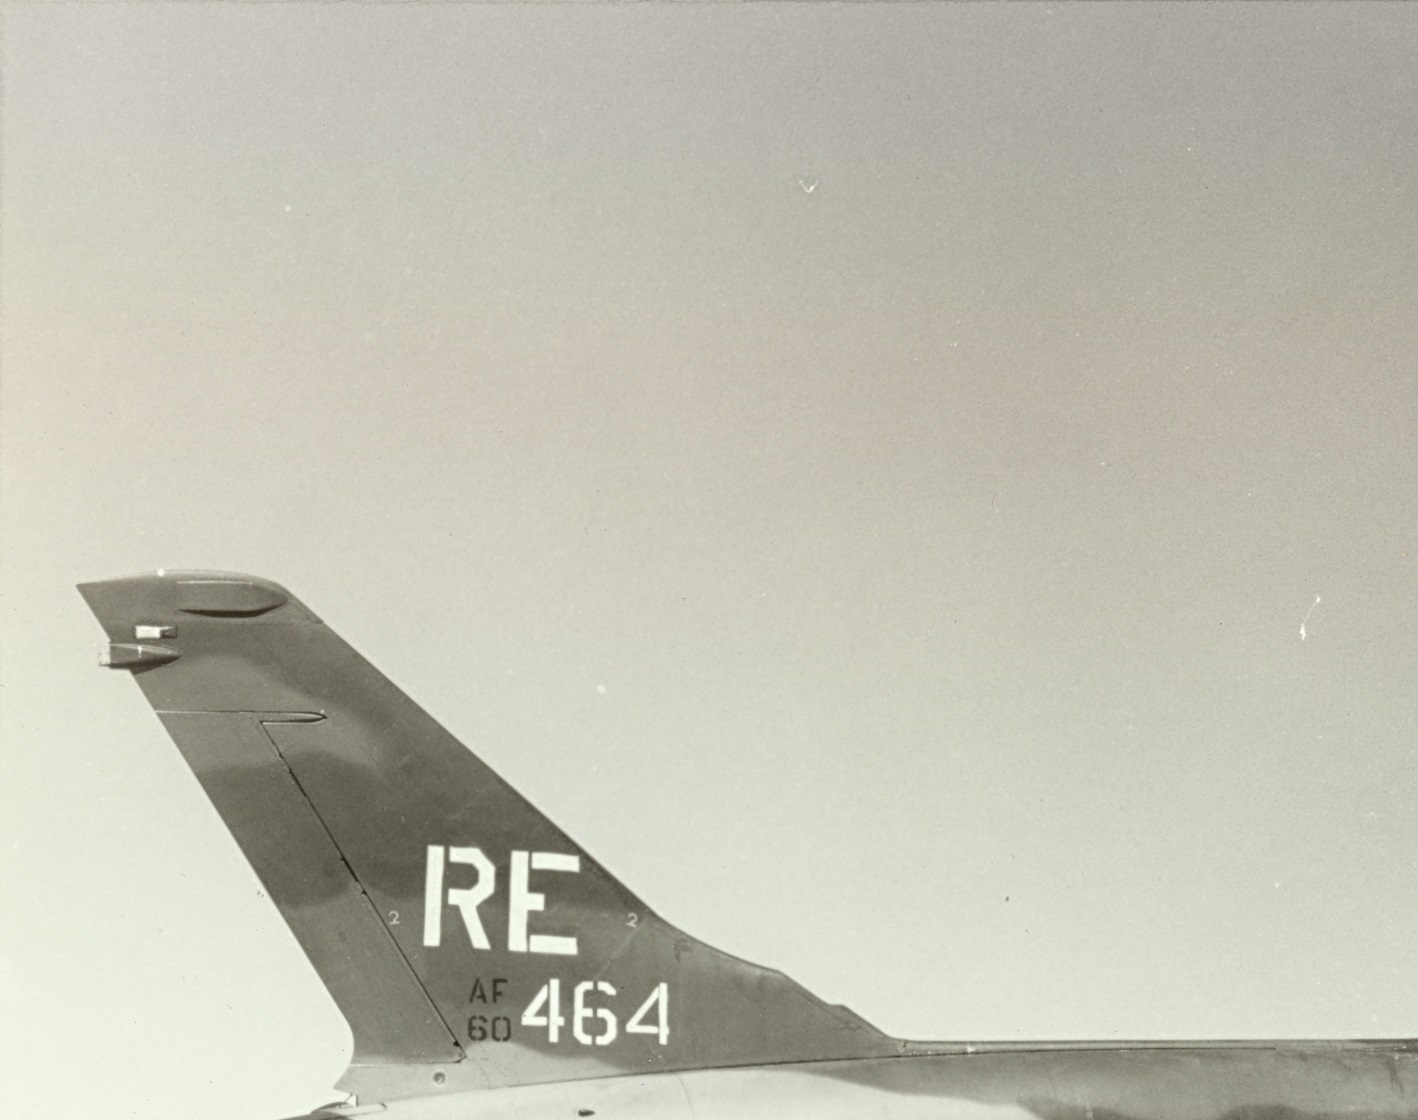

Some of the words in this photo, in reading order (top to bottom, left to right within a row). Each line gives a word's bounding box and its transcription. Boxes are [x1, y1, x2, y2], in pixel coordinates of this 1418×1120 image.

[422, 845, 581, 955] RE
[388, 910, 400, 925] 2
[625, 912, 639, 927] 2
[468, 977, 508, 1004] AF
[521, 978, 669, 1045] 464
[467, 1014, 512, 1042] 60
